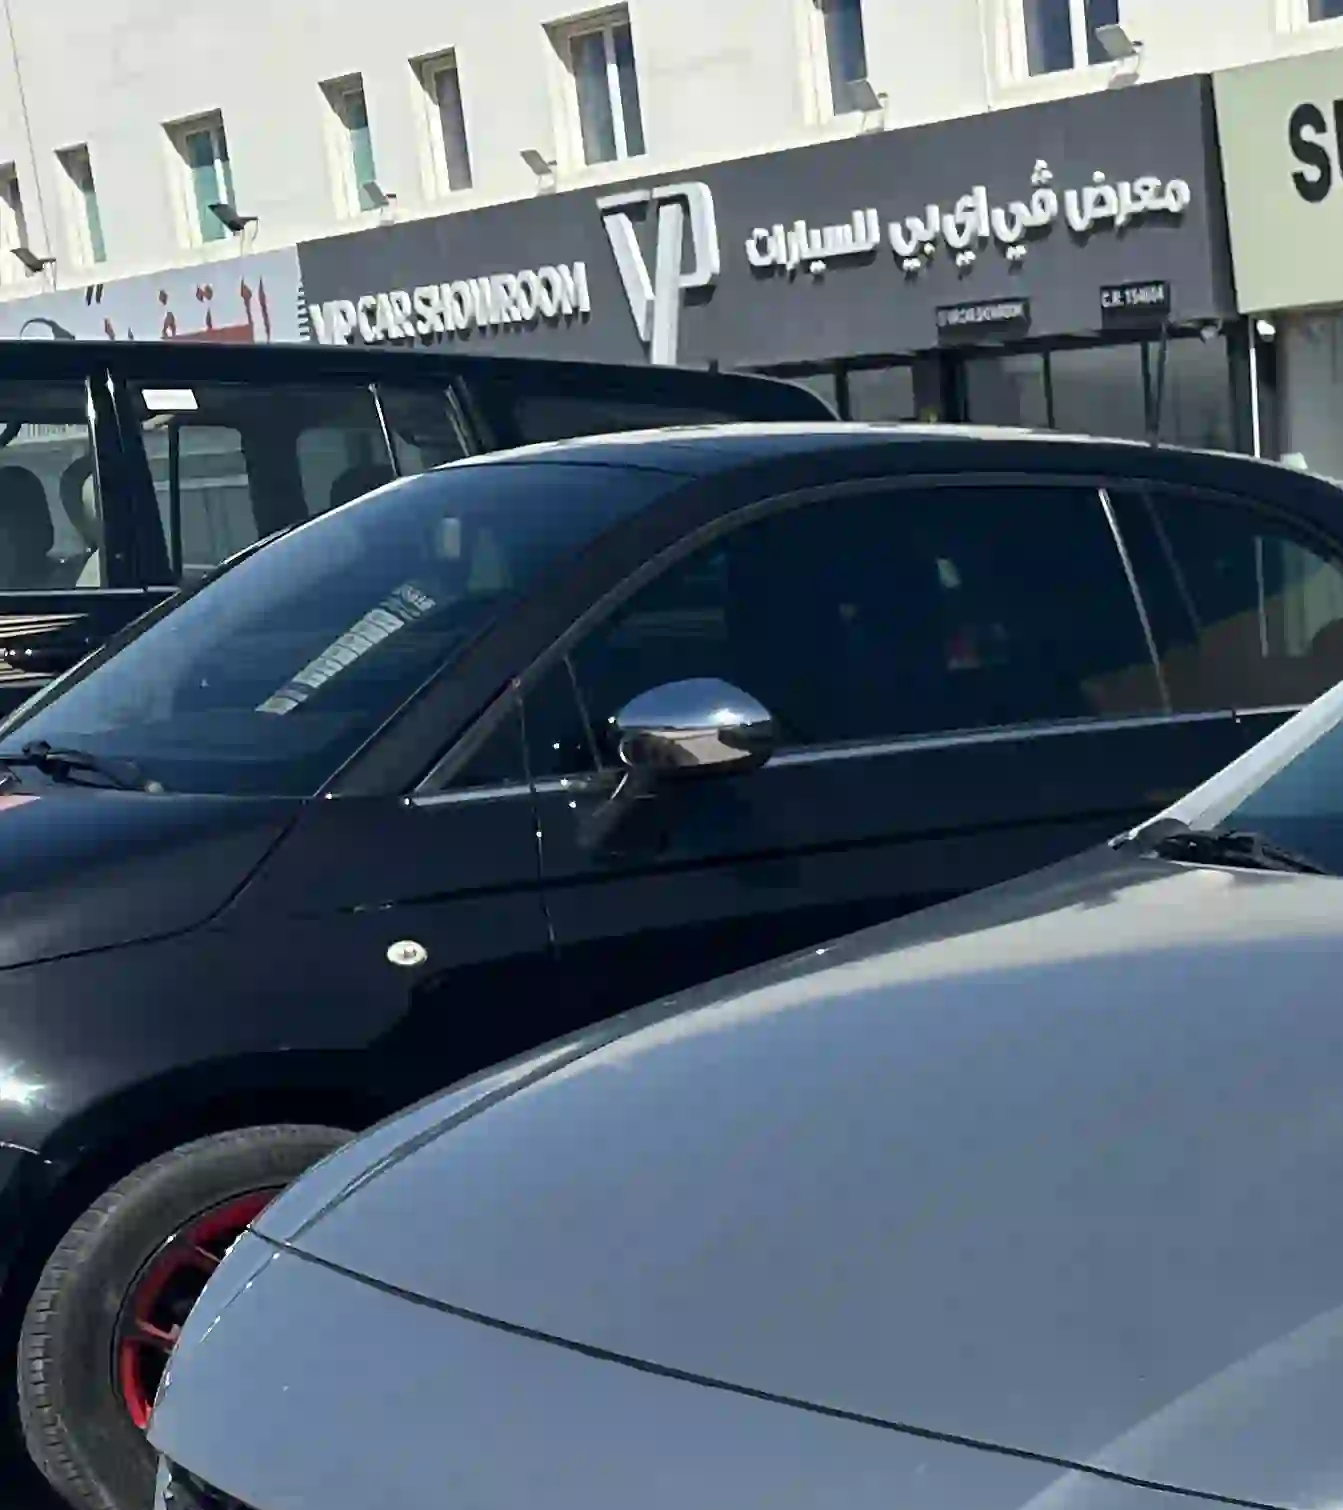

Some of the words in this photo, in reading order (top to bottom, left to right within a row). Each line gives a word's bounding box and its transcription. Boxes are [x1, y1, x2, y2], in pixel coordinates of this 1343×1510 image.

[1064, 170, 1191, 232] معرض
[745, 208, 881, 275] للسيارات
[887, 203, 941, 271] بي
[357, 290, 416, 343] CAR
[413, 261, 591, 335] SHOWROOM
